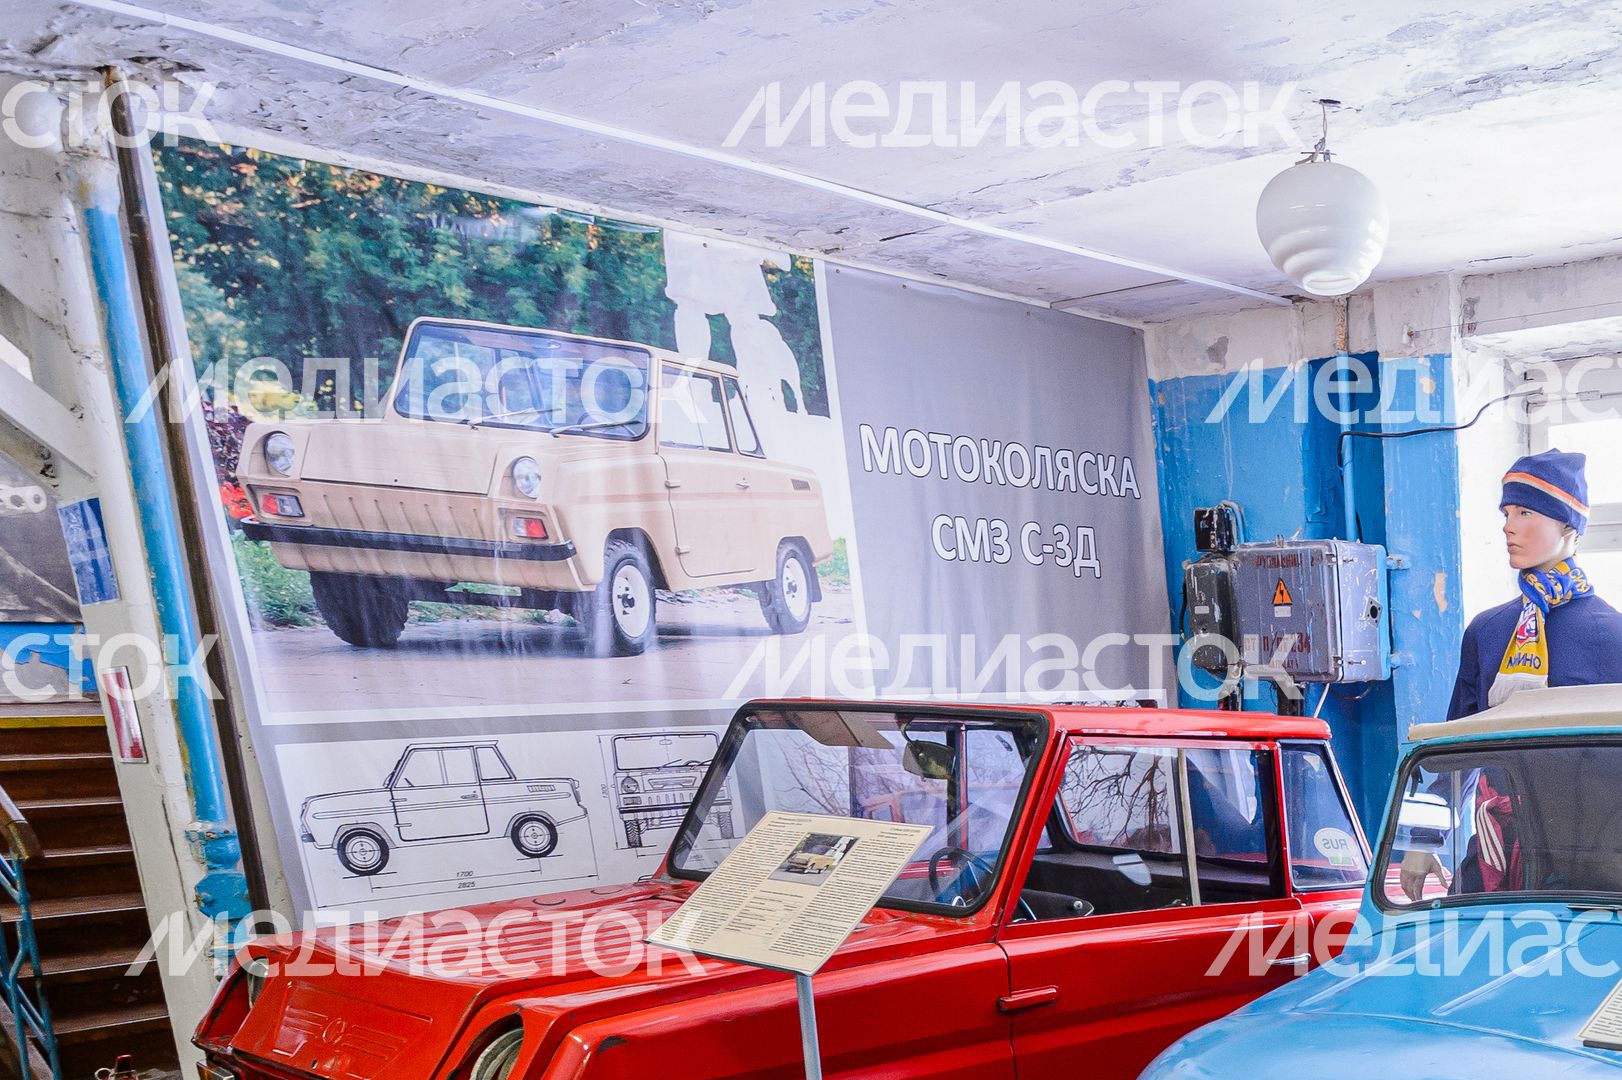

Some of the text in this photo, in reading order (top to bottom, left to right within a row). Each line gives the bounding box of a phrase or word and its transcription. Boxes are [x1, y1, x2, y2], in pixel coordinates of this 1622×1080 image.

[859, 424, 1141, 499] МОТОКОЛЯСКА
[456, 870, 474, 878] 1700
[457, 881, 476, 889] 2825
